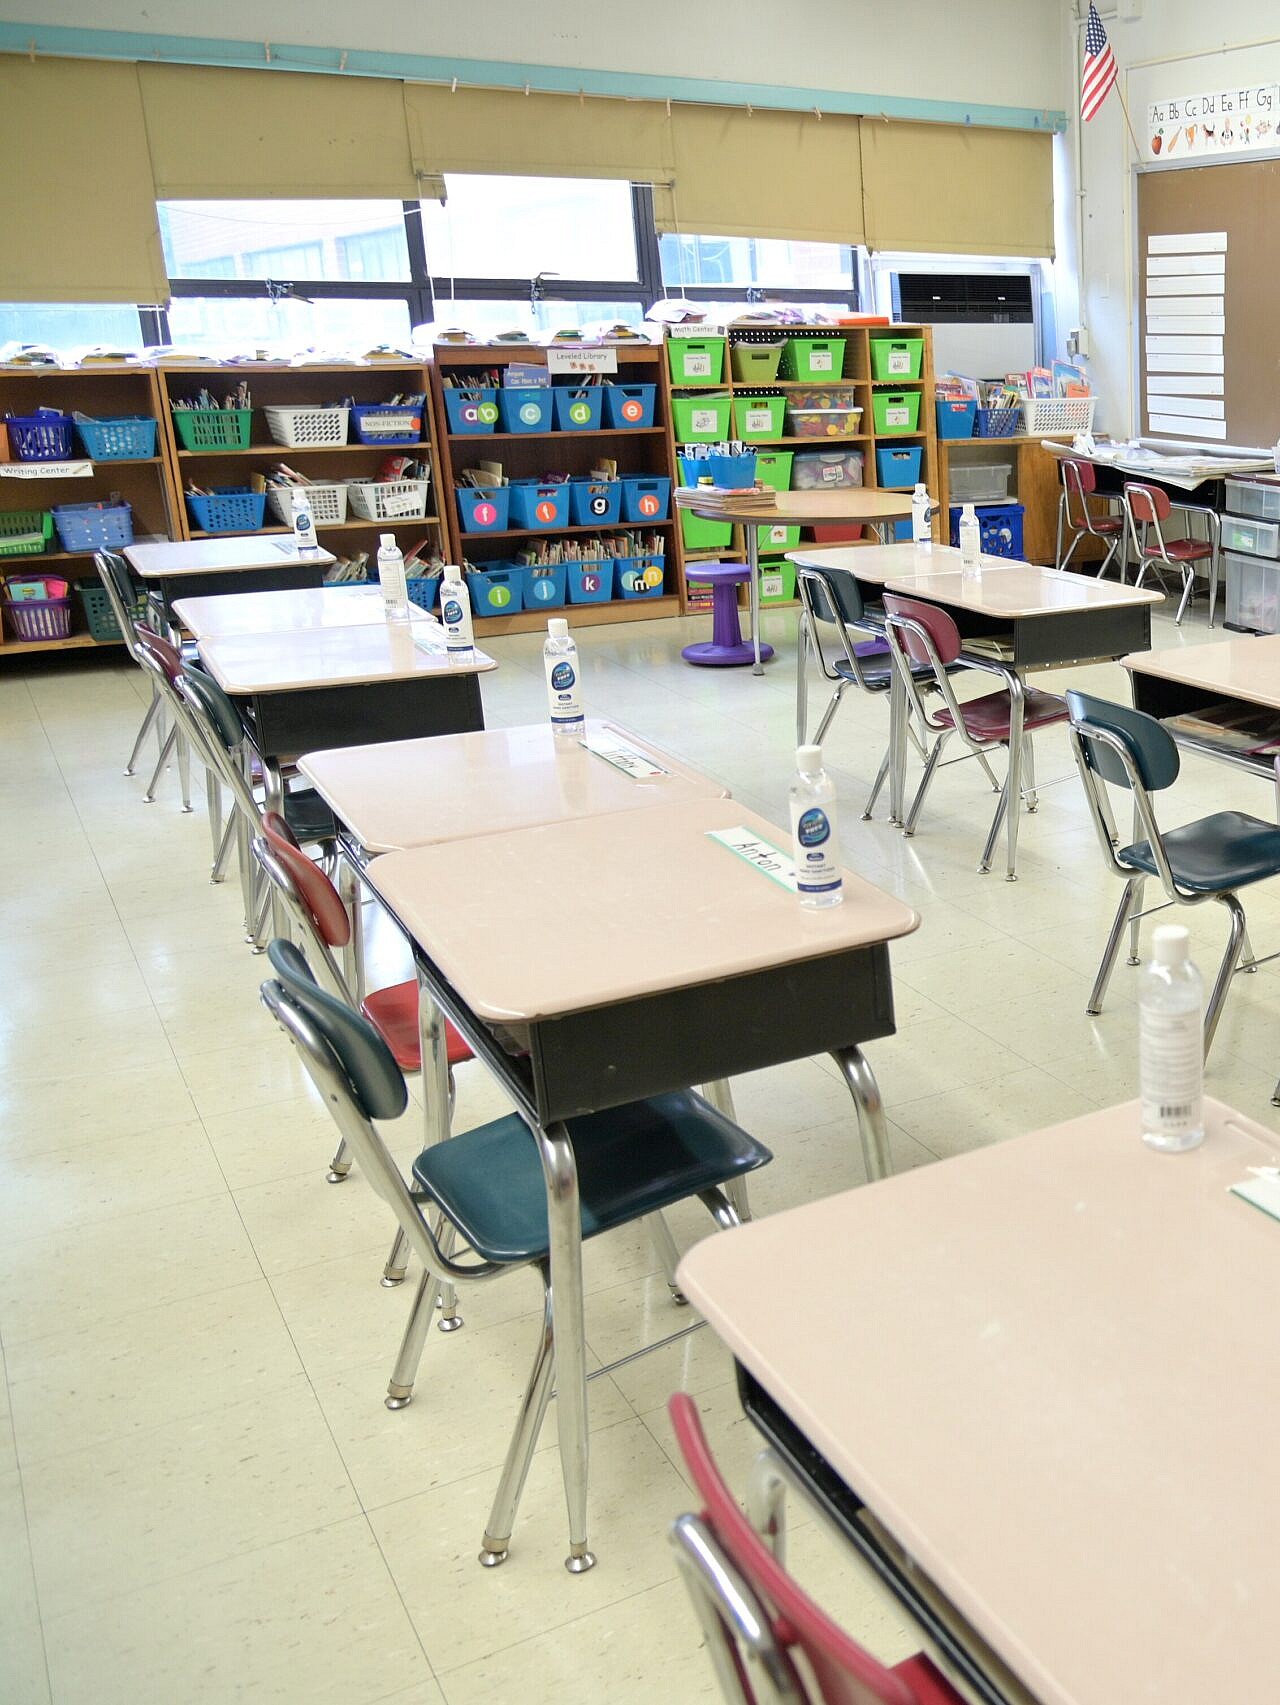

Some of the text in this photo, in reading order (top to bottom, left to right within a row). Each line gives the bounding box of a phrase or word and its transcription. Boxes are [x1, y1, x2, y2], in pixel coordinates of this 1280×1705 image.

[1153, 106, 1163, 122] Aa
[1170, 103, 1179, 119] Bb
[1185, 100, 1196, 117] Cc
[1202, 97, 1214, 114] Dd
[1222, 94, 1232, 111] Ee
[1239, 92, 1249, 109] Ff
[1257, 88, 1272, 111] Gg
[465, 407, 477, 420] a
[482, 406, 495, 420] b
[524, 407, 535, 420] c
[575, 405, 586, 421] d
[626, 405, 638, 417] e
[4, 467, 37, 476] Writing
[594, 499, 606, 515] g
[645, 499, 654, 512] h
[481, 506, 490, 522] f
[585, 577, 594, 590] k
[635, 580, 649, 591] m
[497, 589, 502, 604] i
[732, 842, 781, 872] Anton
